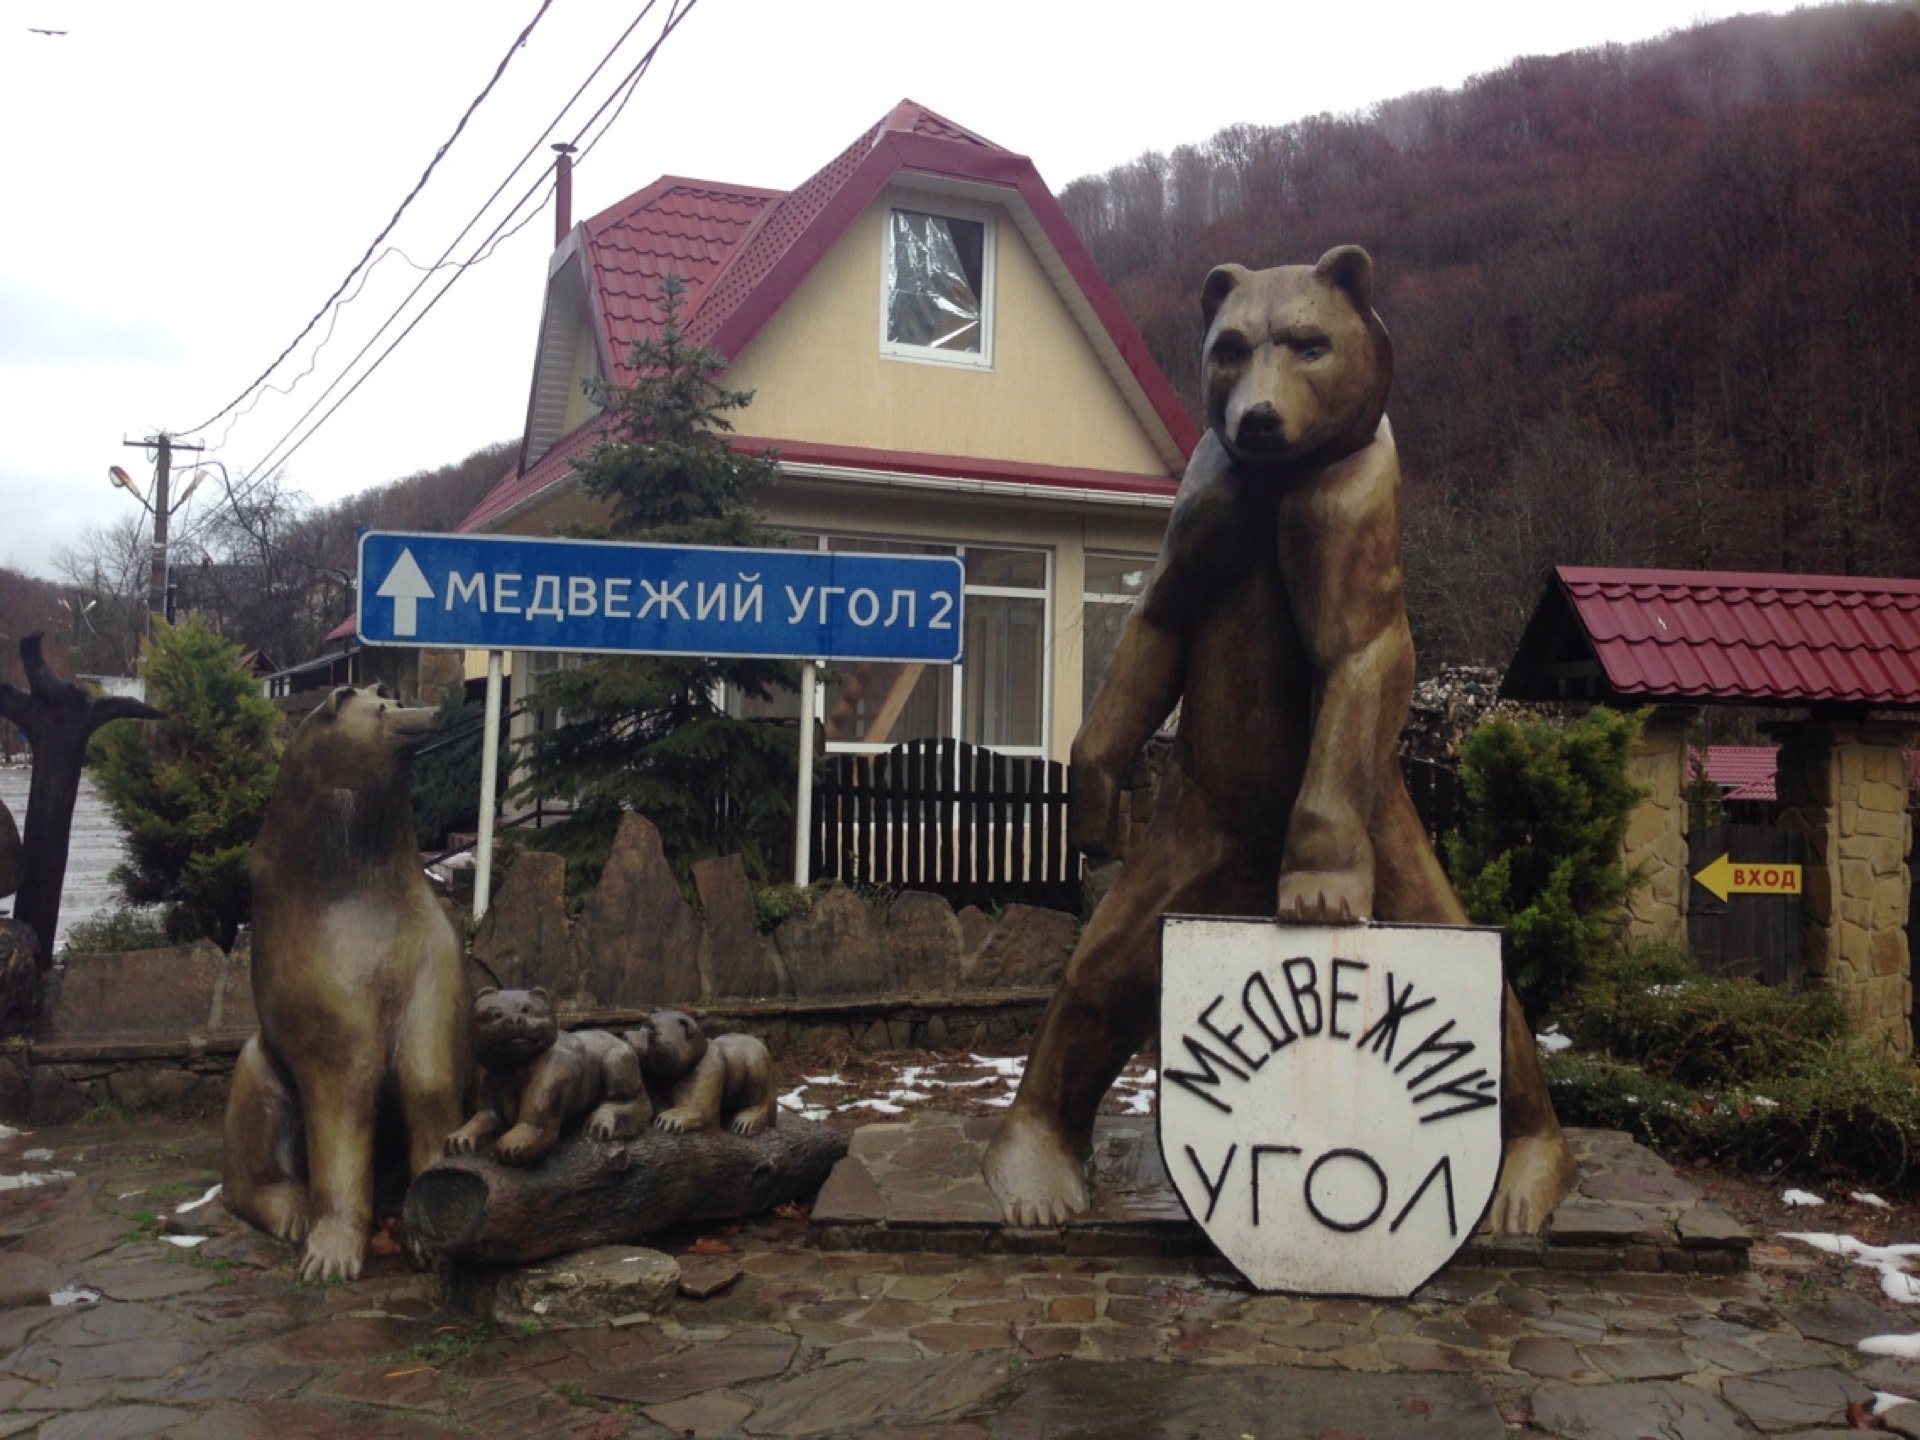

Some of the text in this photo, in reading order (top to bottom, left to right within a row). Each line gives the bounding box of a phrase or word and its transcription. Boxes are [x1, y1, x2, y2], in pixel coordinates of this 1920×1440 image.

[444, 570, 954, 630] МЕДВЕЖИЙ УГОЛ 2
[1733, 869, 1796, 889] ВХОД
[1163, 956, 1498, 1124] МЕДВЕЖИЙ
[1184, 1142, 1459, 1237] УГОЛ
